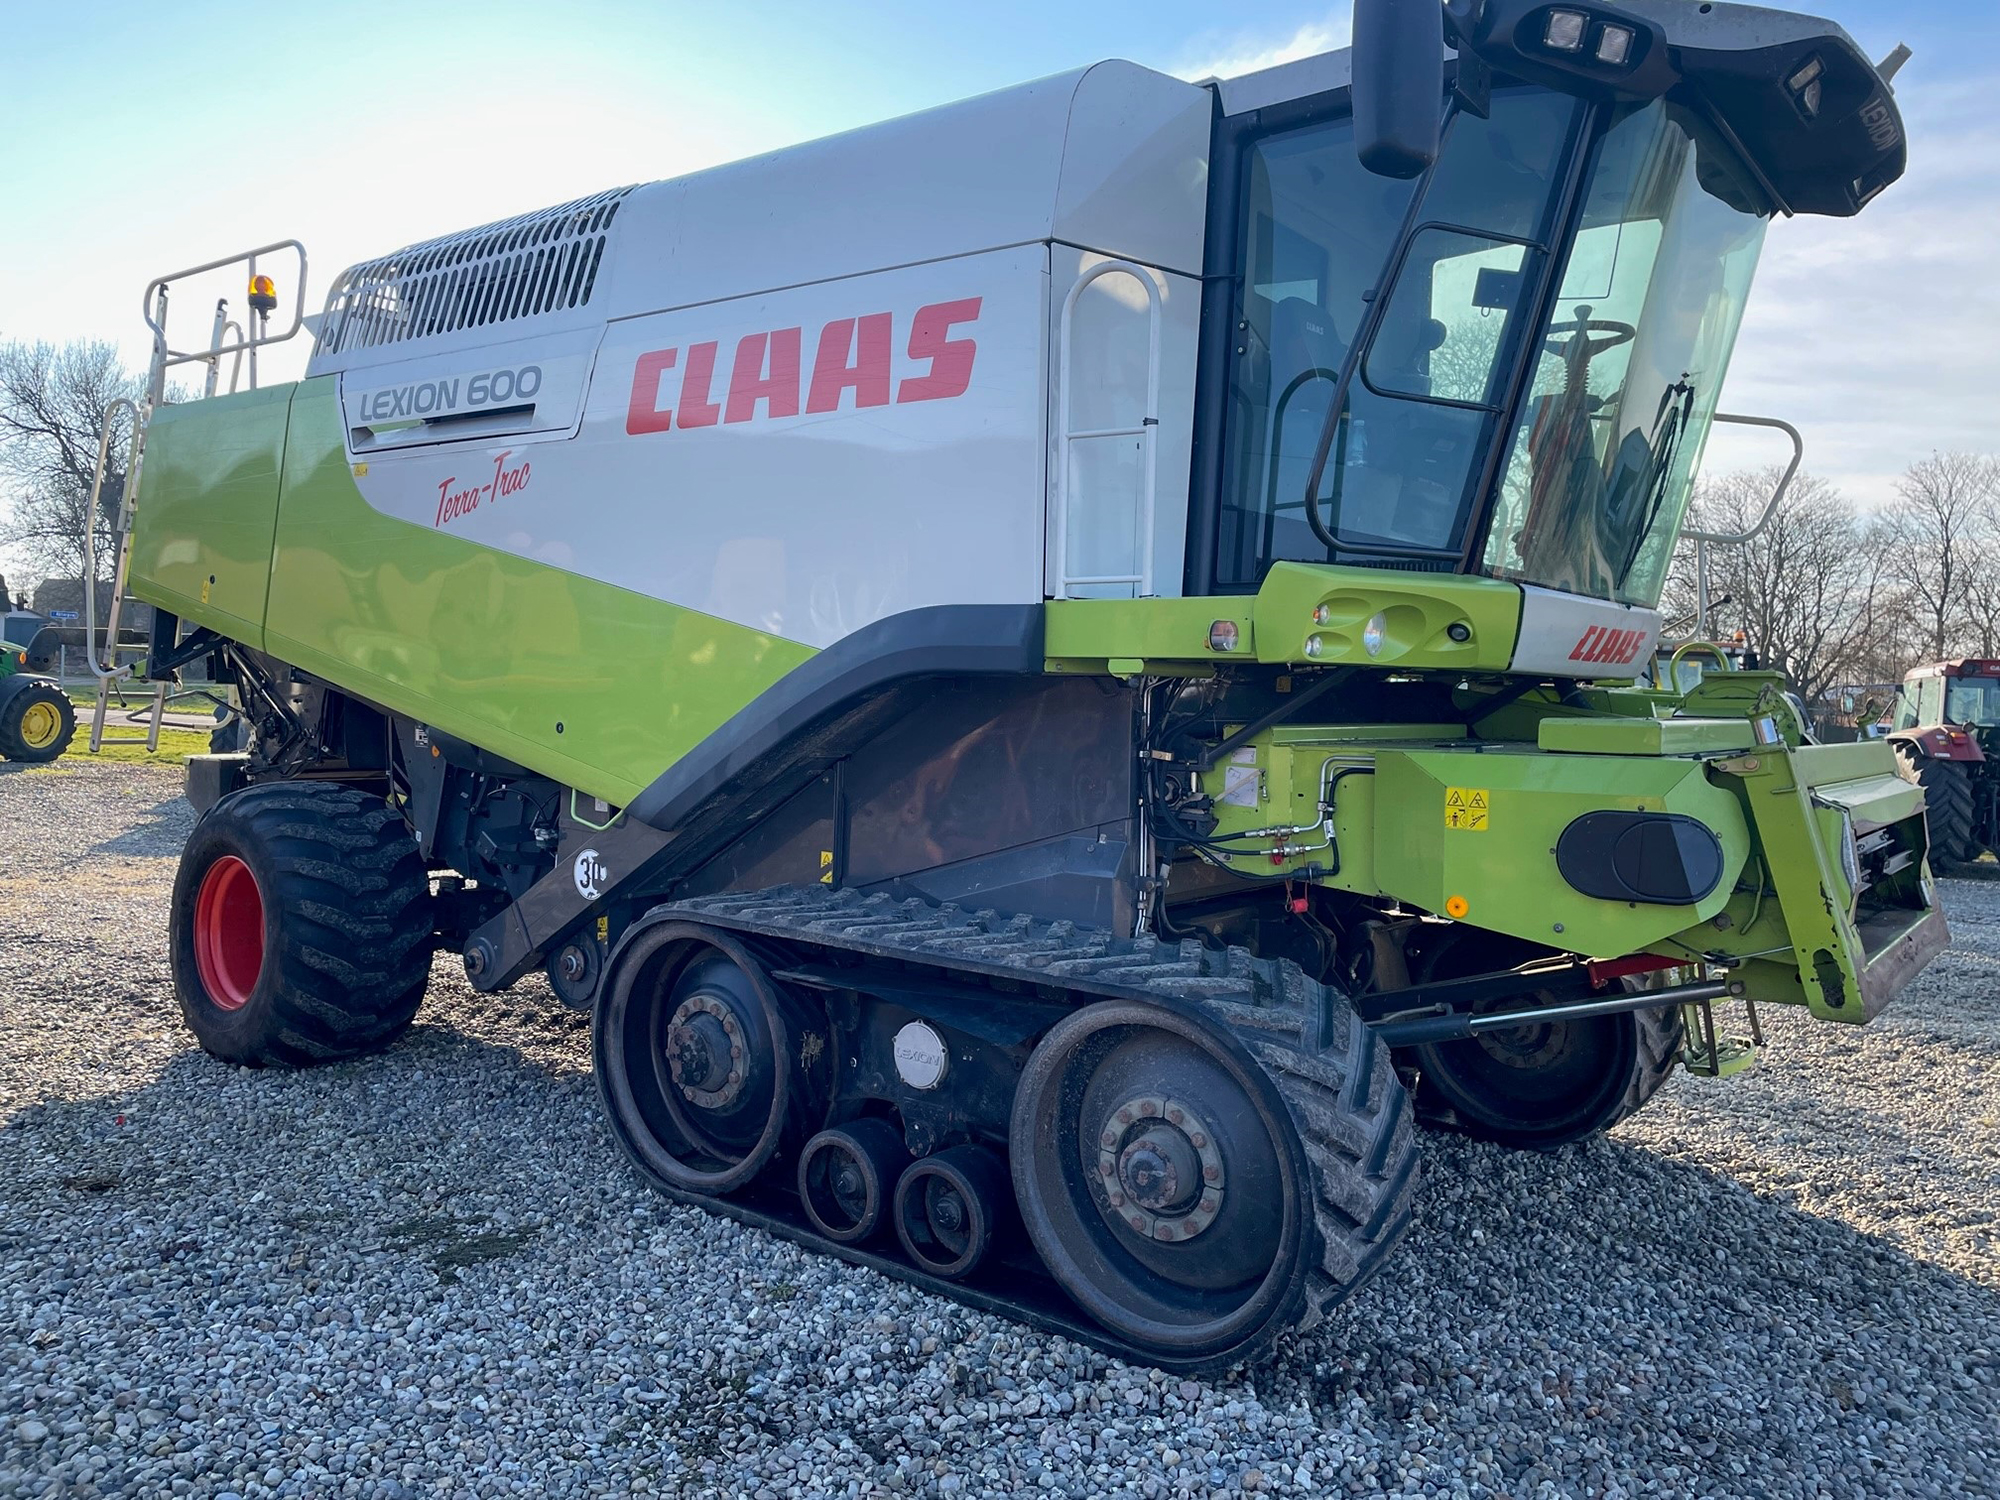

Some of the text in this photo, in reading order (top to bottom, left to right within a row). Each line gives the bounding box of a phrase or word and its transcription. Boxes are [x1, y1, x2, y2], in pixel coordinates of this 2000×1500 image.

[1859, 98, 1899, 151] LEXION
[626, 296, 983, 436] CLAAS
[359, 366, 542, 422] LEXION 600
[435, 450, 532, 528] Terra-Trac
[1567, 625, 1648, 665] CLAAS
[896, 1047, 940, 1066] LEXION
